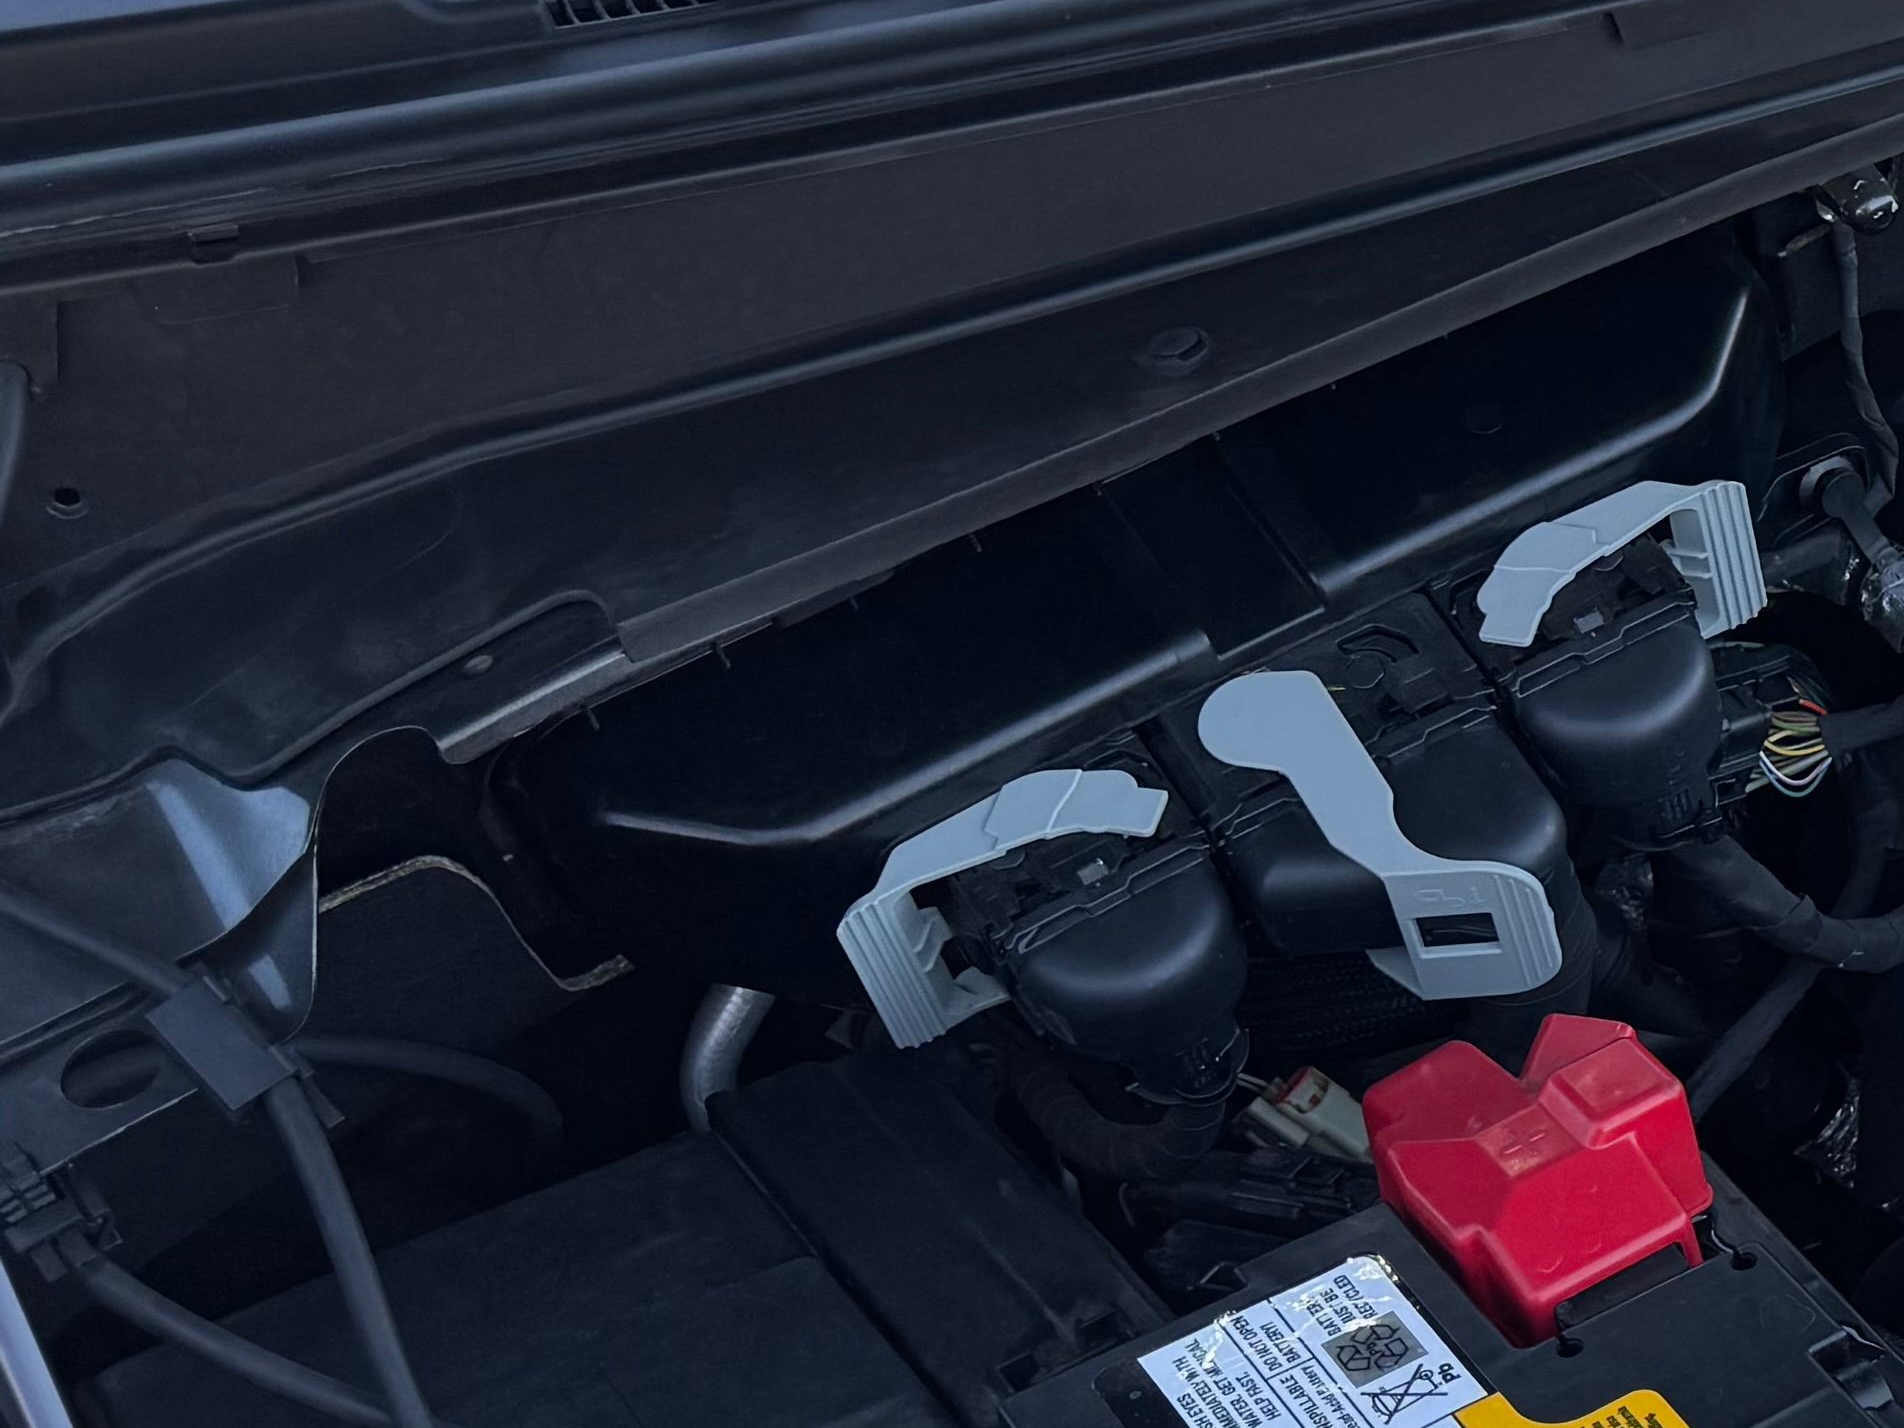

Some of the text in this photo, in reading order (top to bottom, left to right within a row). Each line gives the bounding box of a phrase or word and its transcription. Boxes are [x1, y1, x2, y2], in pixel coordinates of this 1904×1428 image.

[1318, 1287, 1338, 1302] BE
[1230, 1314, 1283, 1371] DO NOT OPEN
[1183, 1338, 1223, 1378] MEICAL
[1434, 1361, 1461, 1383] Pb
[1213, 1376, 1237, 1396] GET
[1175, 1392, 1204, 1418] EYES
[1253, 1394, 1281, 1420] HELP
